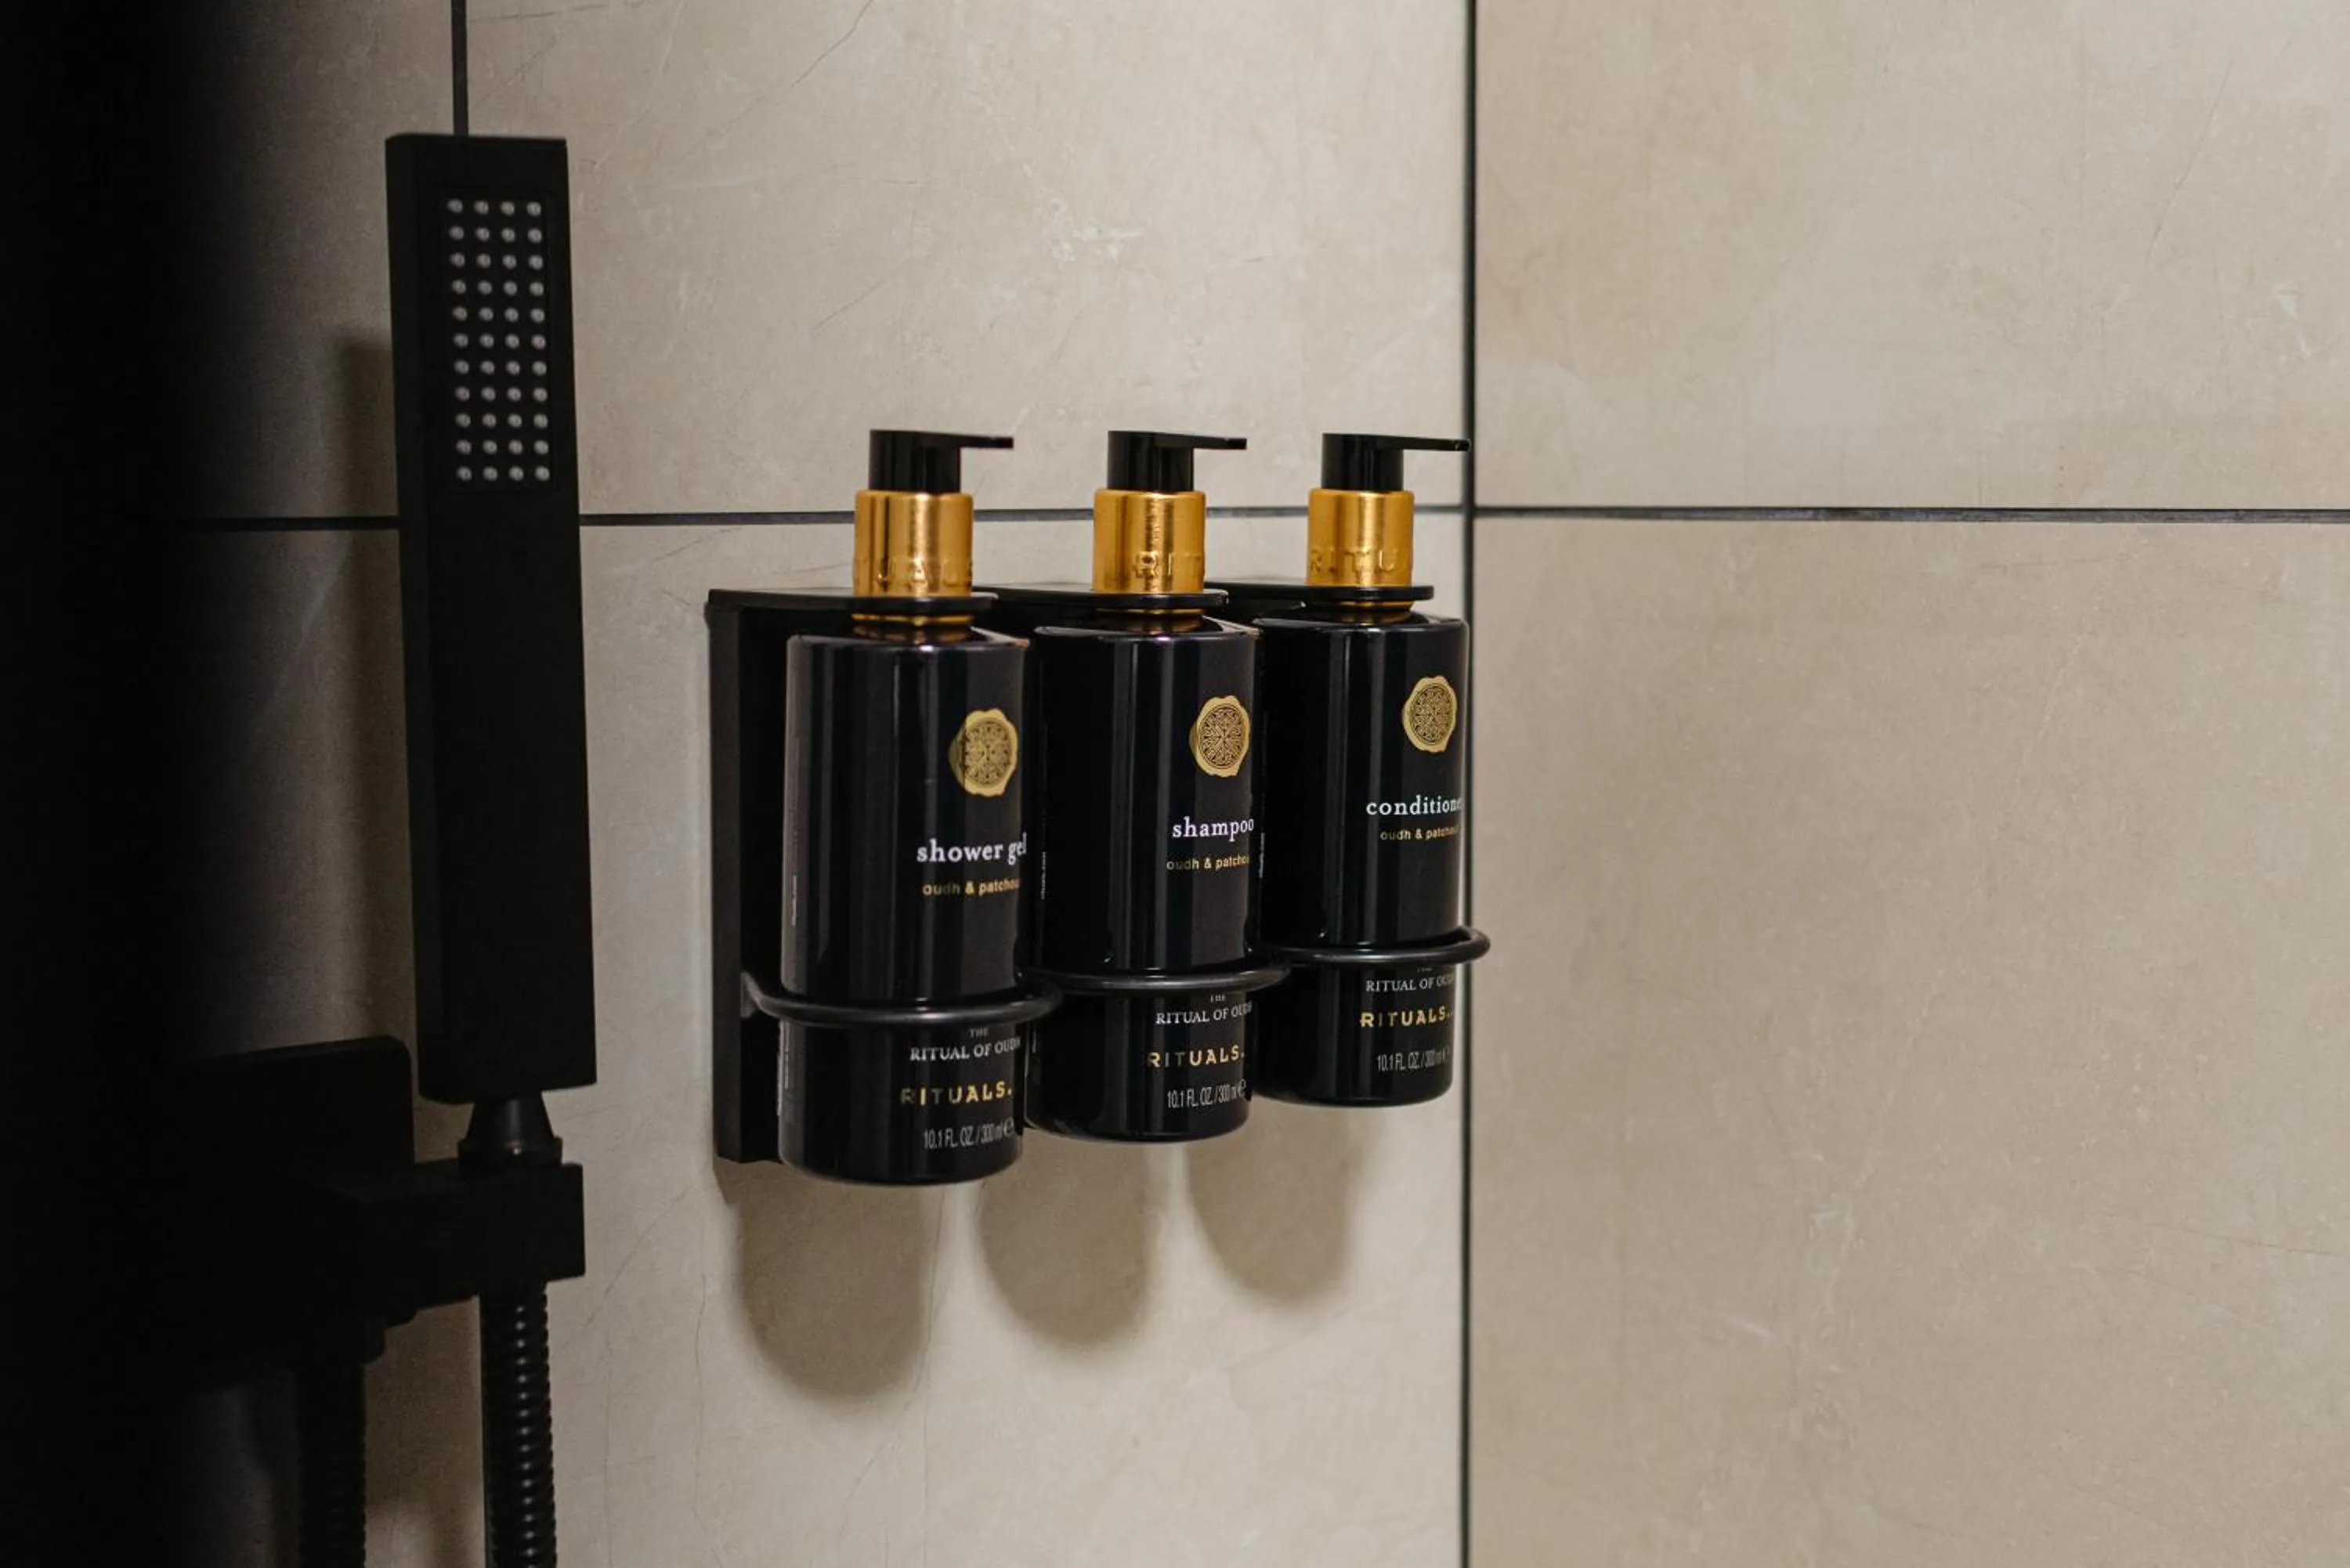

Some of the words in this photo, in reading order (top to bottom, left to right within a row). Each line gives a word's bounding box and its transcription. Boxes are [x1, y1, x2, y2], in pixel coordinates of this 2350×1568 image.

[1172, 815, 1254, 842] shampoo
[1380, 829, 1411, 841] oudh
[1415, 828, 1423, 840] &
[916, 837, 1003, 863] shower
[1166, 857, 1199, 870] oudh
[1204, 857, 1213, 869] &
[922, 881, 961, 896] oudh
[964, 880, 974, 896] &
[1366, 979, 1416, 992] RITUAL
[1419, 977, 1434, 989] OF
[1155, 1010, 1210, 1025] RITUAL
[1213, 1008, 1229, 1021] OF
[909, 1046, 971, 1061] RITUAL
[973, 1042, 992, 1057] OF
[1147, 1044, 1245, 1068] RITUALS.
[901, 1080, 1013, 1106] RITUALS.
